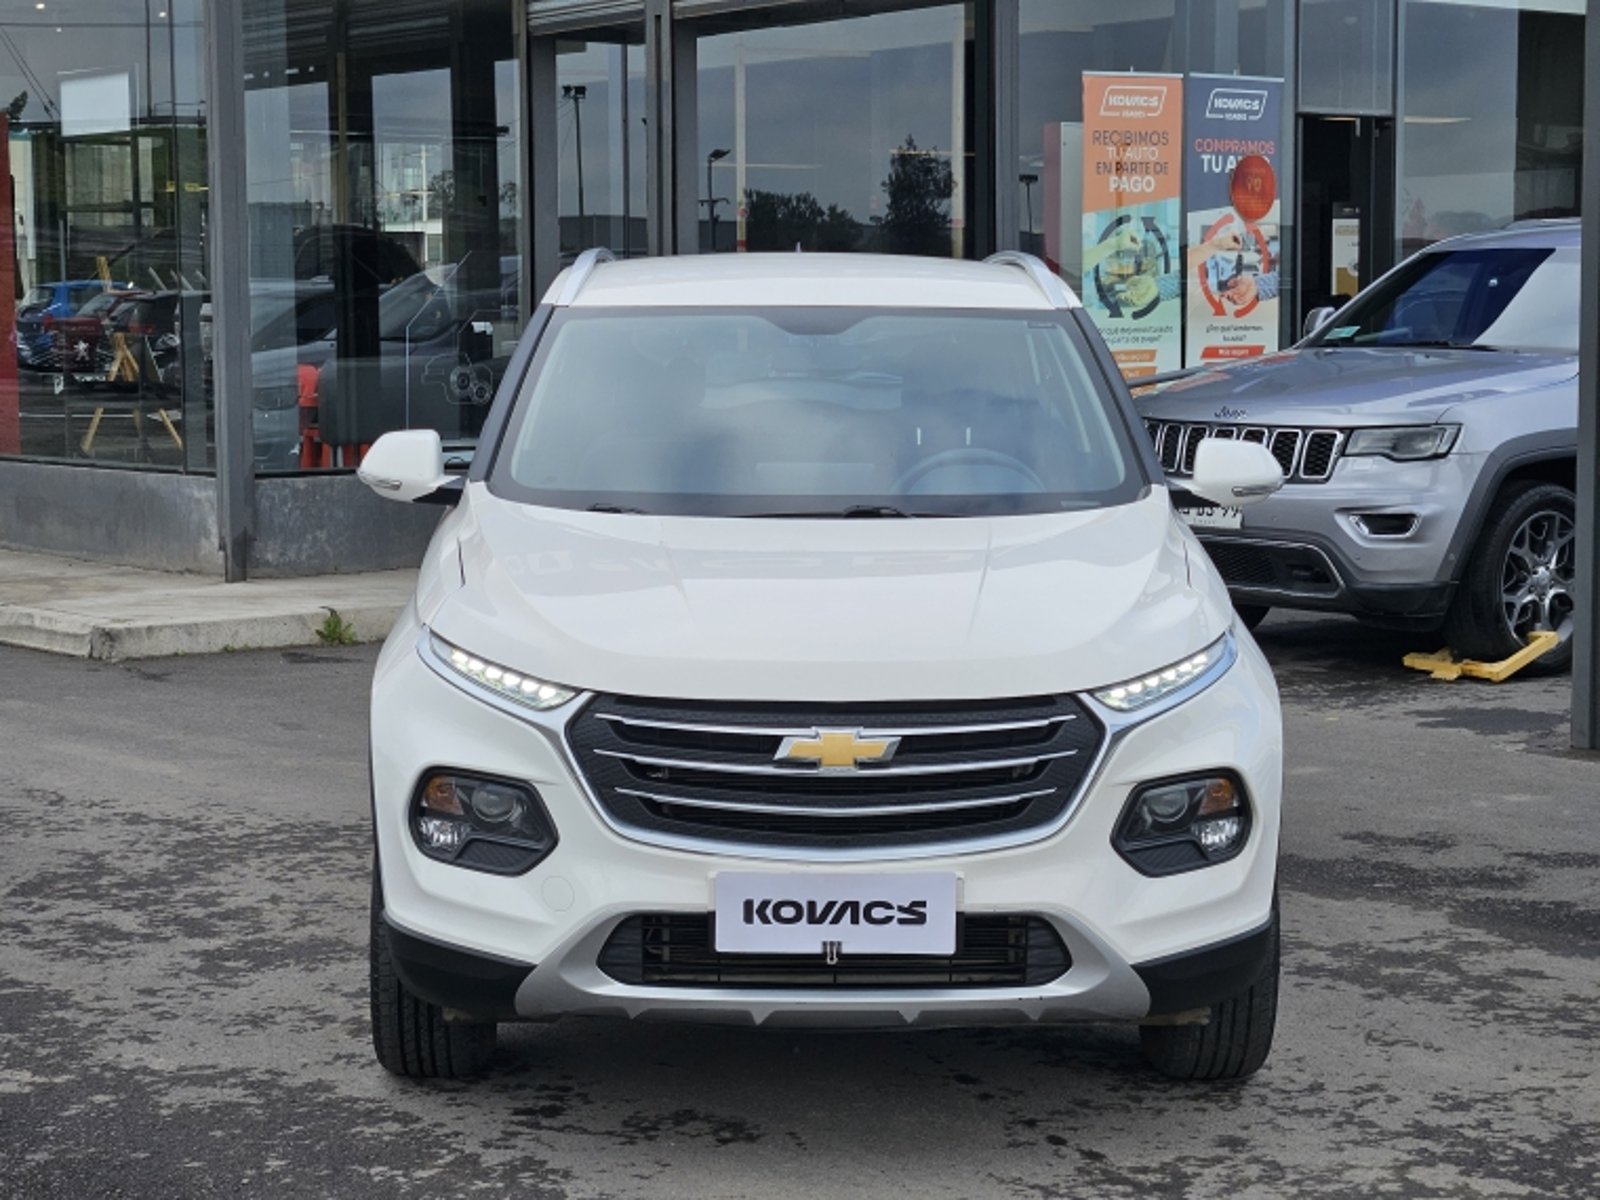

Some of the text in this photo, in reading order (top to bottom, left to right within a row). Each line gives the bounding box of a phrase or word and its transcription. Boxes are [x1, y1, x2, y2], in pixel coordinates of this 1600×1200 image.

[1108, 94, 1159, 107] KOVACS
[1214, 98, 1260, 111] KOVACS
[1092, 130, 1169, 146] RECIBIMOS
[1106, 146, 1159, 161] TU AUTO
[1194, 138, 1275, 155] COMPRAMOS
[1096, 161, 1169, 175] EN PARTE DE
[1201, 154, 1222, 173] TU
[1109, 175, 1156, 193] PAGO
[743, 898, 927, 925] KOVACS
